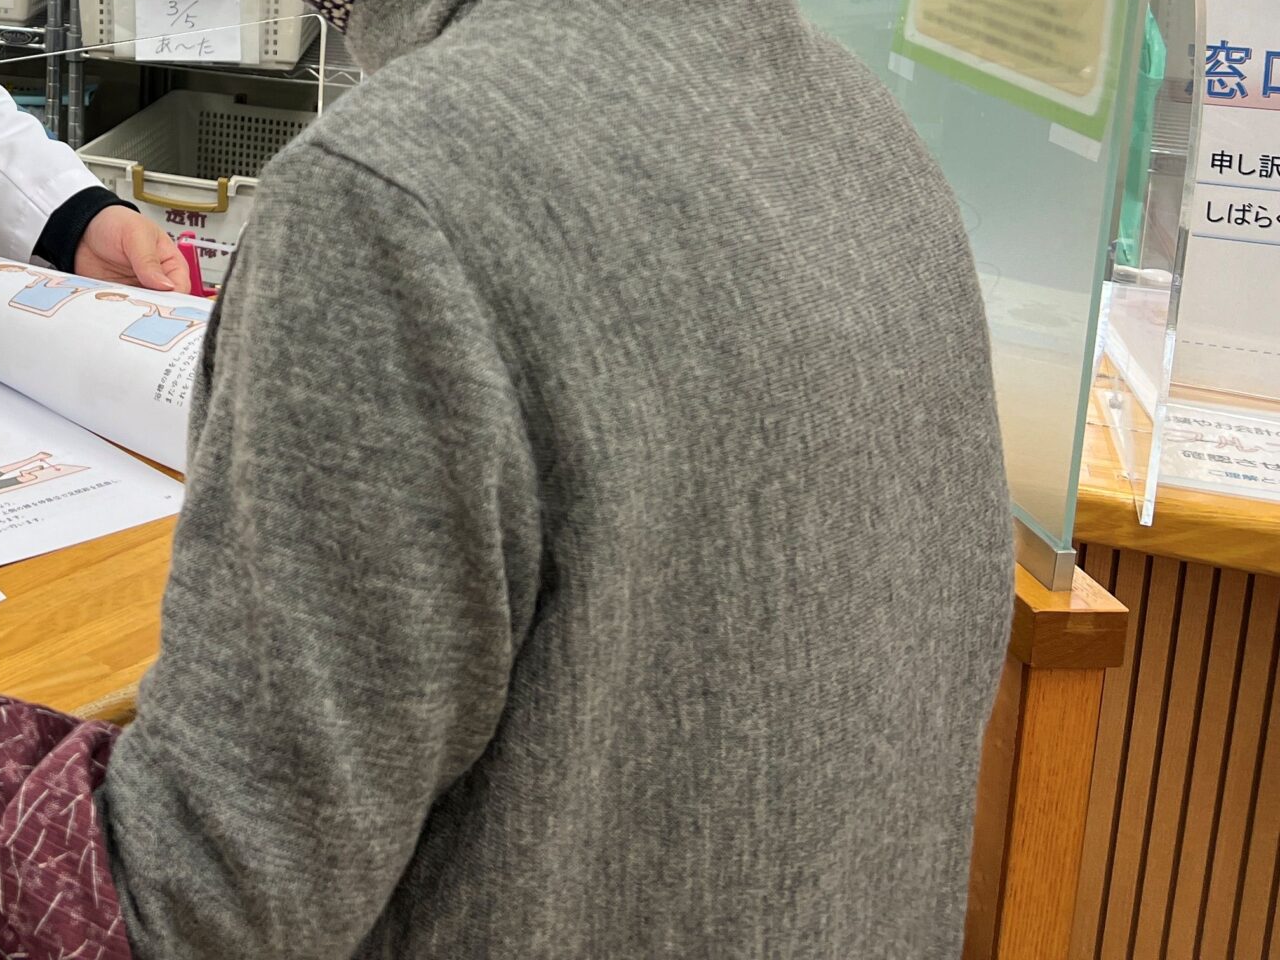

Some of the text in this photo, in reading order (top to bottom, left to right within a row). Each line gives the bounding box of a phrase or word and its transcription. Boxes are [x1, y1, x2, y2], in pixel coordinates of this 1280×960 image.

[166, 0, 199, 29] 3/5
[1206, 201, 1280, 228] しばら
